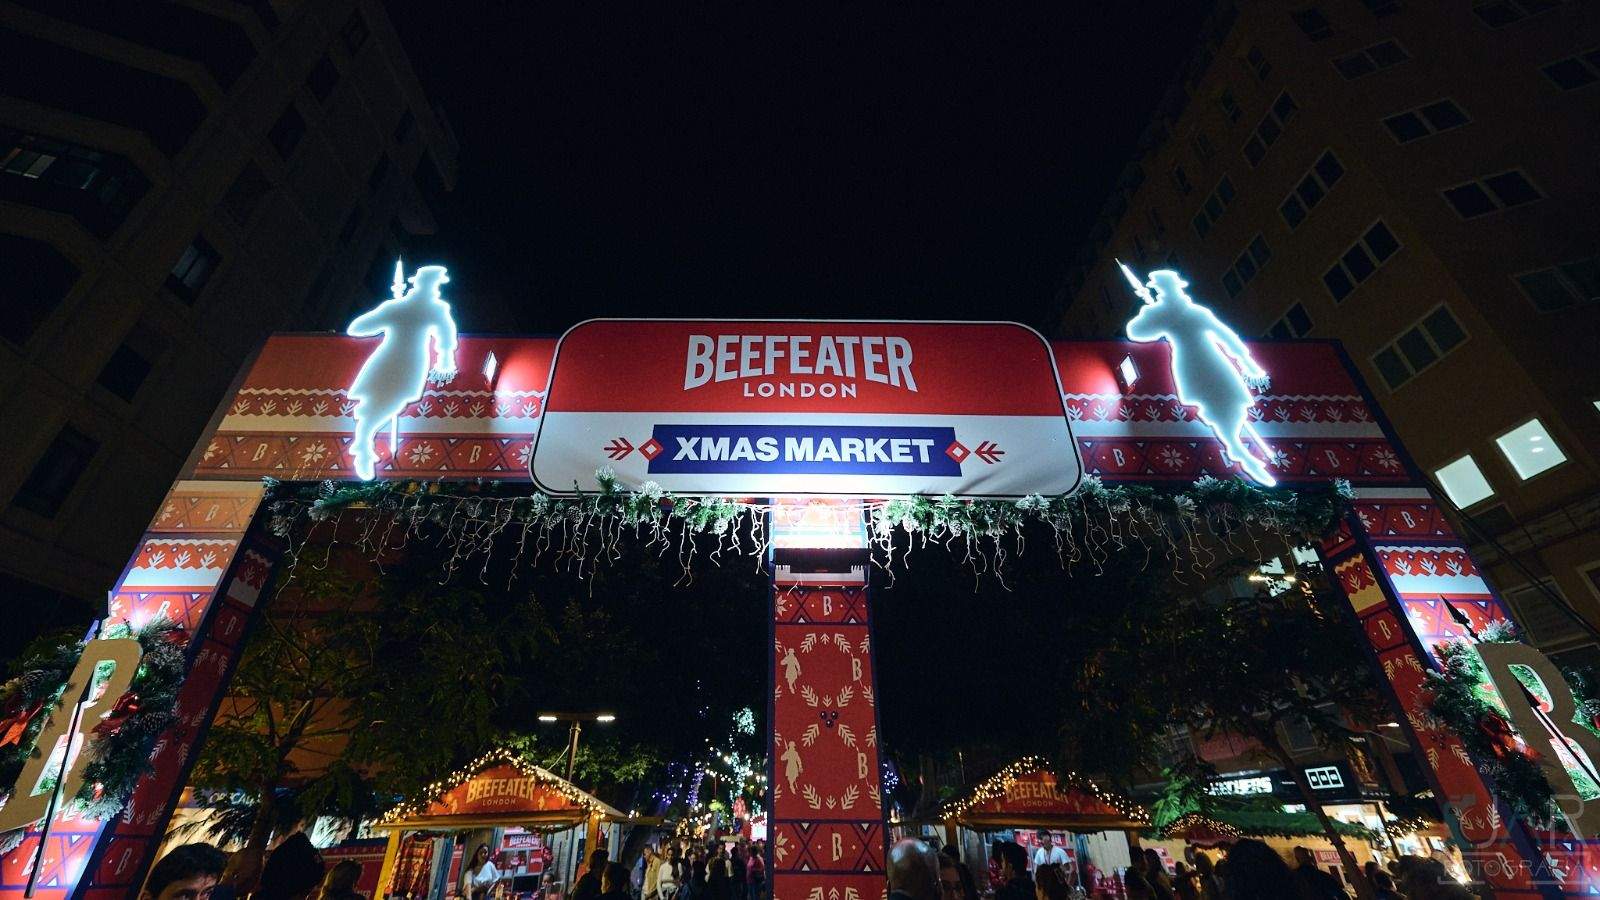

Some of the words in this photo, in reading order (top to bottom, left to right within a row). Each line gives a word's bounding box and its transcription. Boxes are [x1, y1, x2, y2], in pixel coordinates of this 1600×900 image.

[683, 334, 918, 392] BEEFEATER
[743, 382, 858, 399] LONDON
[252, 443, 268, 461] B
[469, 445, 481, 463] B
[672, 436, 779, 463] XMAS
[784, 437, 935, 464] MARKET
[1112, 448, 1126, 468] B
[1401, 510, 1416, 529] B
[823, 595, 832, 616] B
[1378, 619, 1392, 640] B
[852, 658, 863, 681] B
[857, 751, 869, 780] B
[466, 777, 536, 804] BEEFEATER
[482, 798, 517, 807] LONDON
[1022, 799, 1055, 808] LONDON
[832, 832, 843, 861] B
